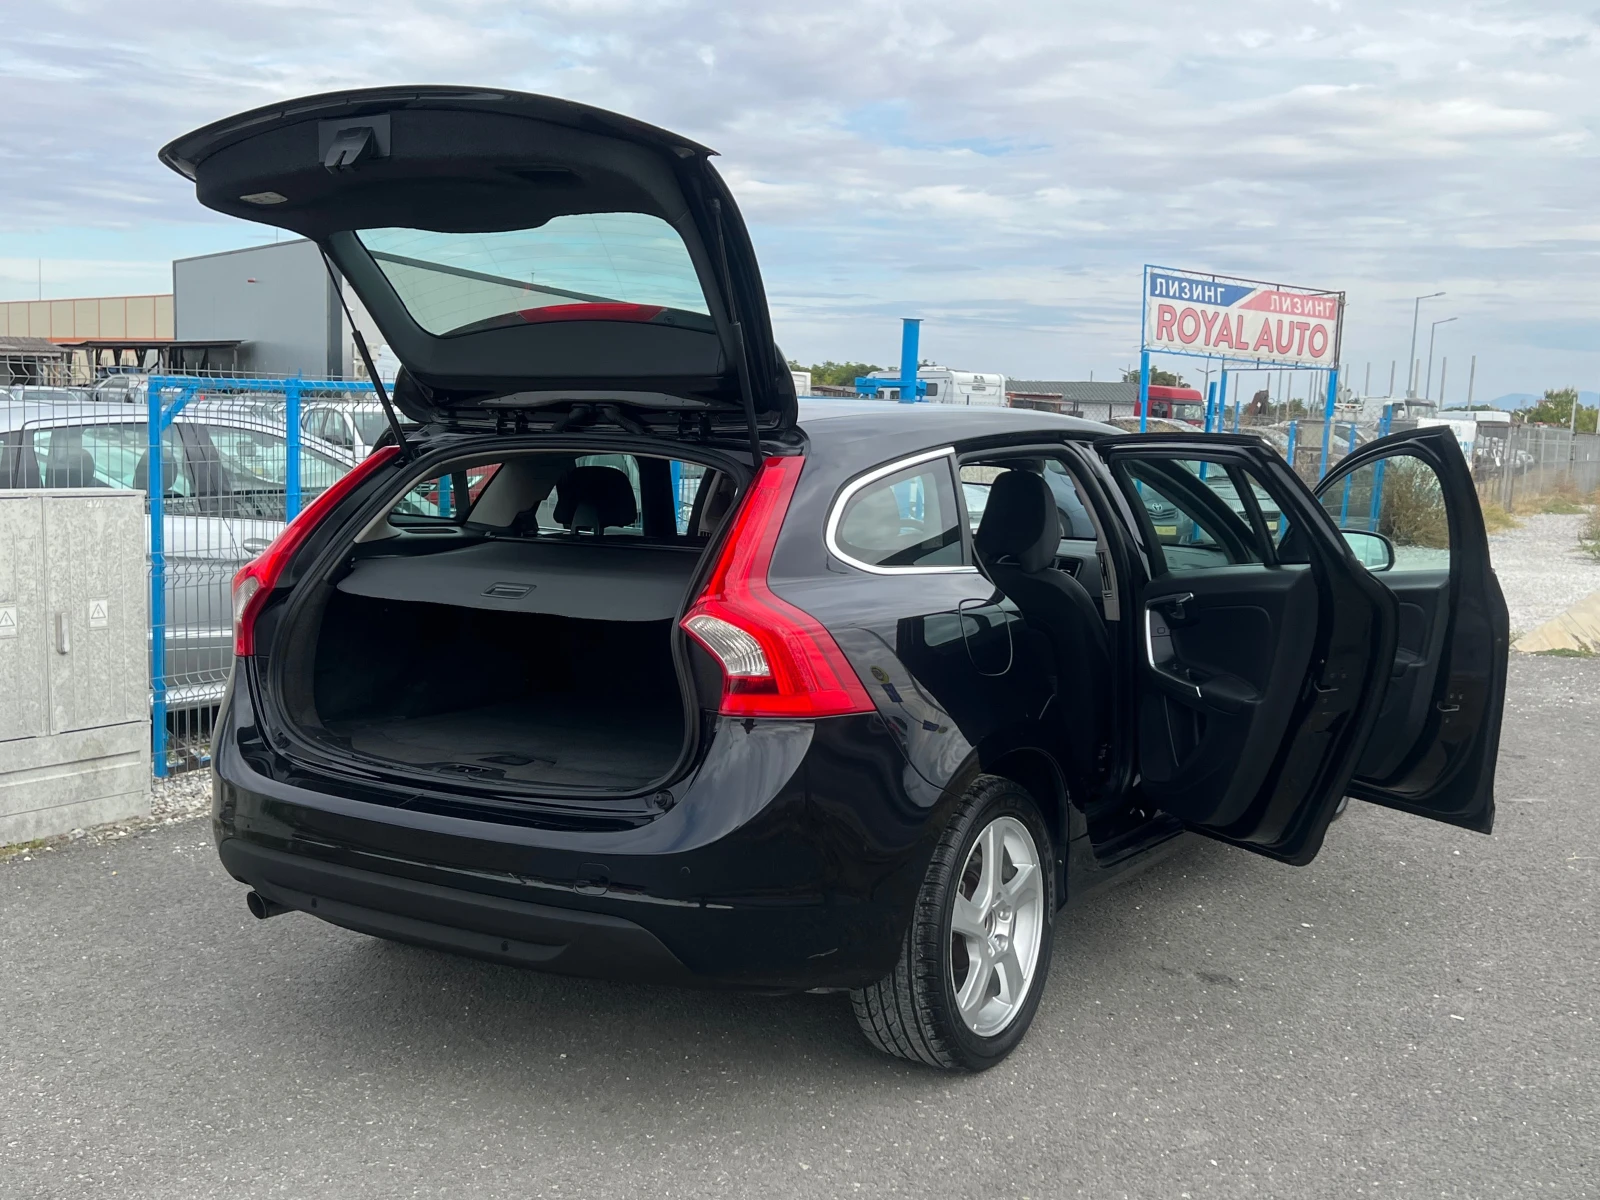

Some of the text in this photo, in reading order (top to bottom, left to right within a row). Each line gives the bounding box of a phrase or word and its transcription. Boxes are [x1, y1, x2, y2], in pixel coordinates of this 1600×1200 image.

[1154, 278, 1225, 304] ЛИЗИНГ
[1270, 295, 1333, 317] ЛИЗИНГ
[1156, 303, 1328, 359] ROYAL AUTO
